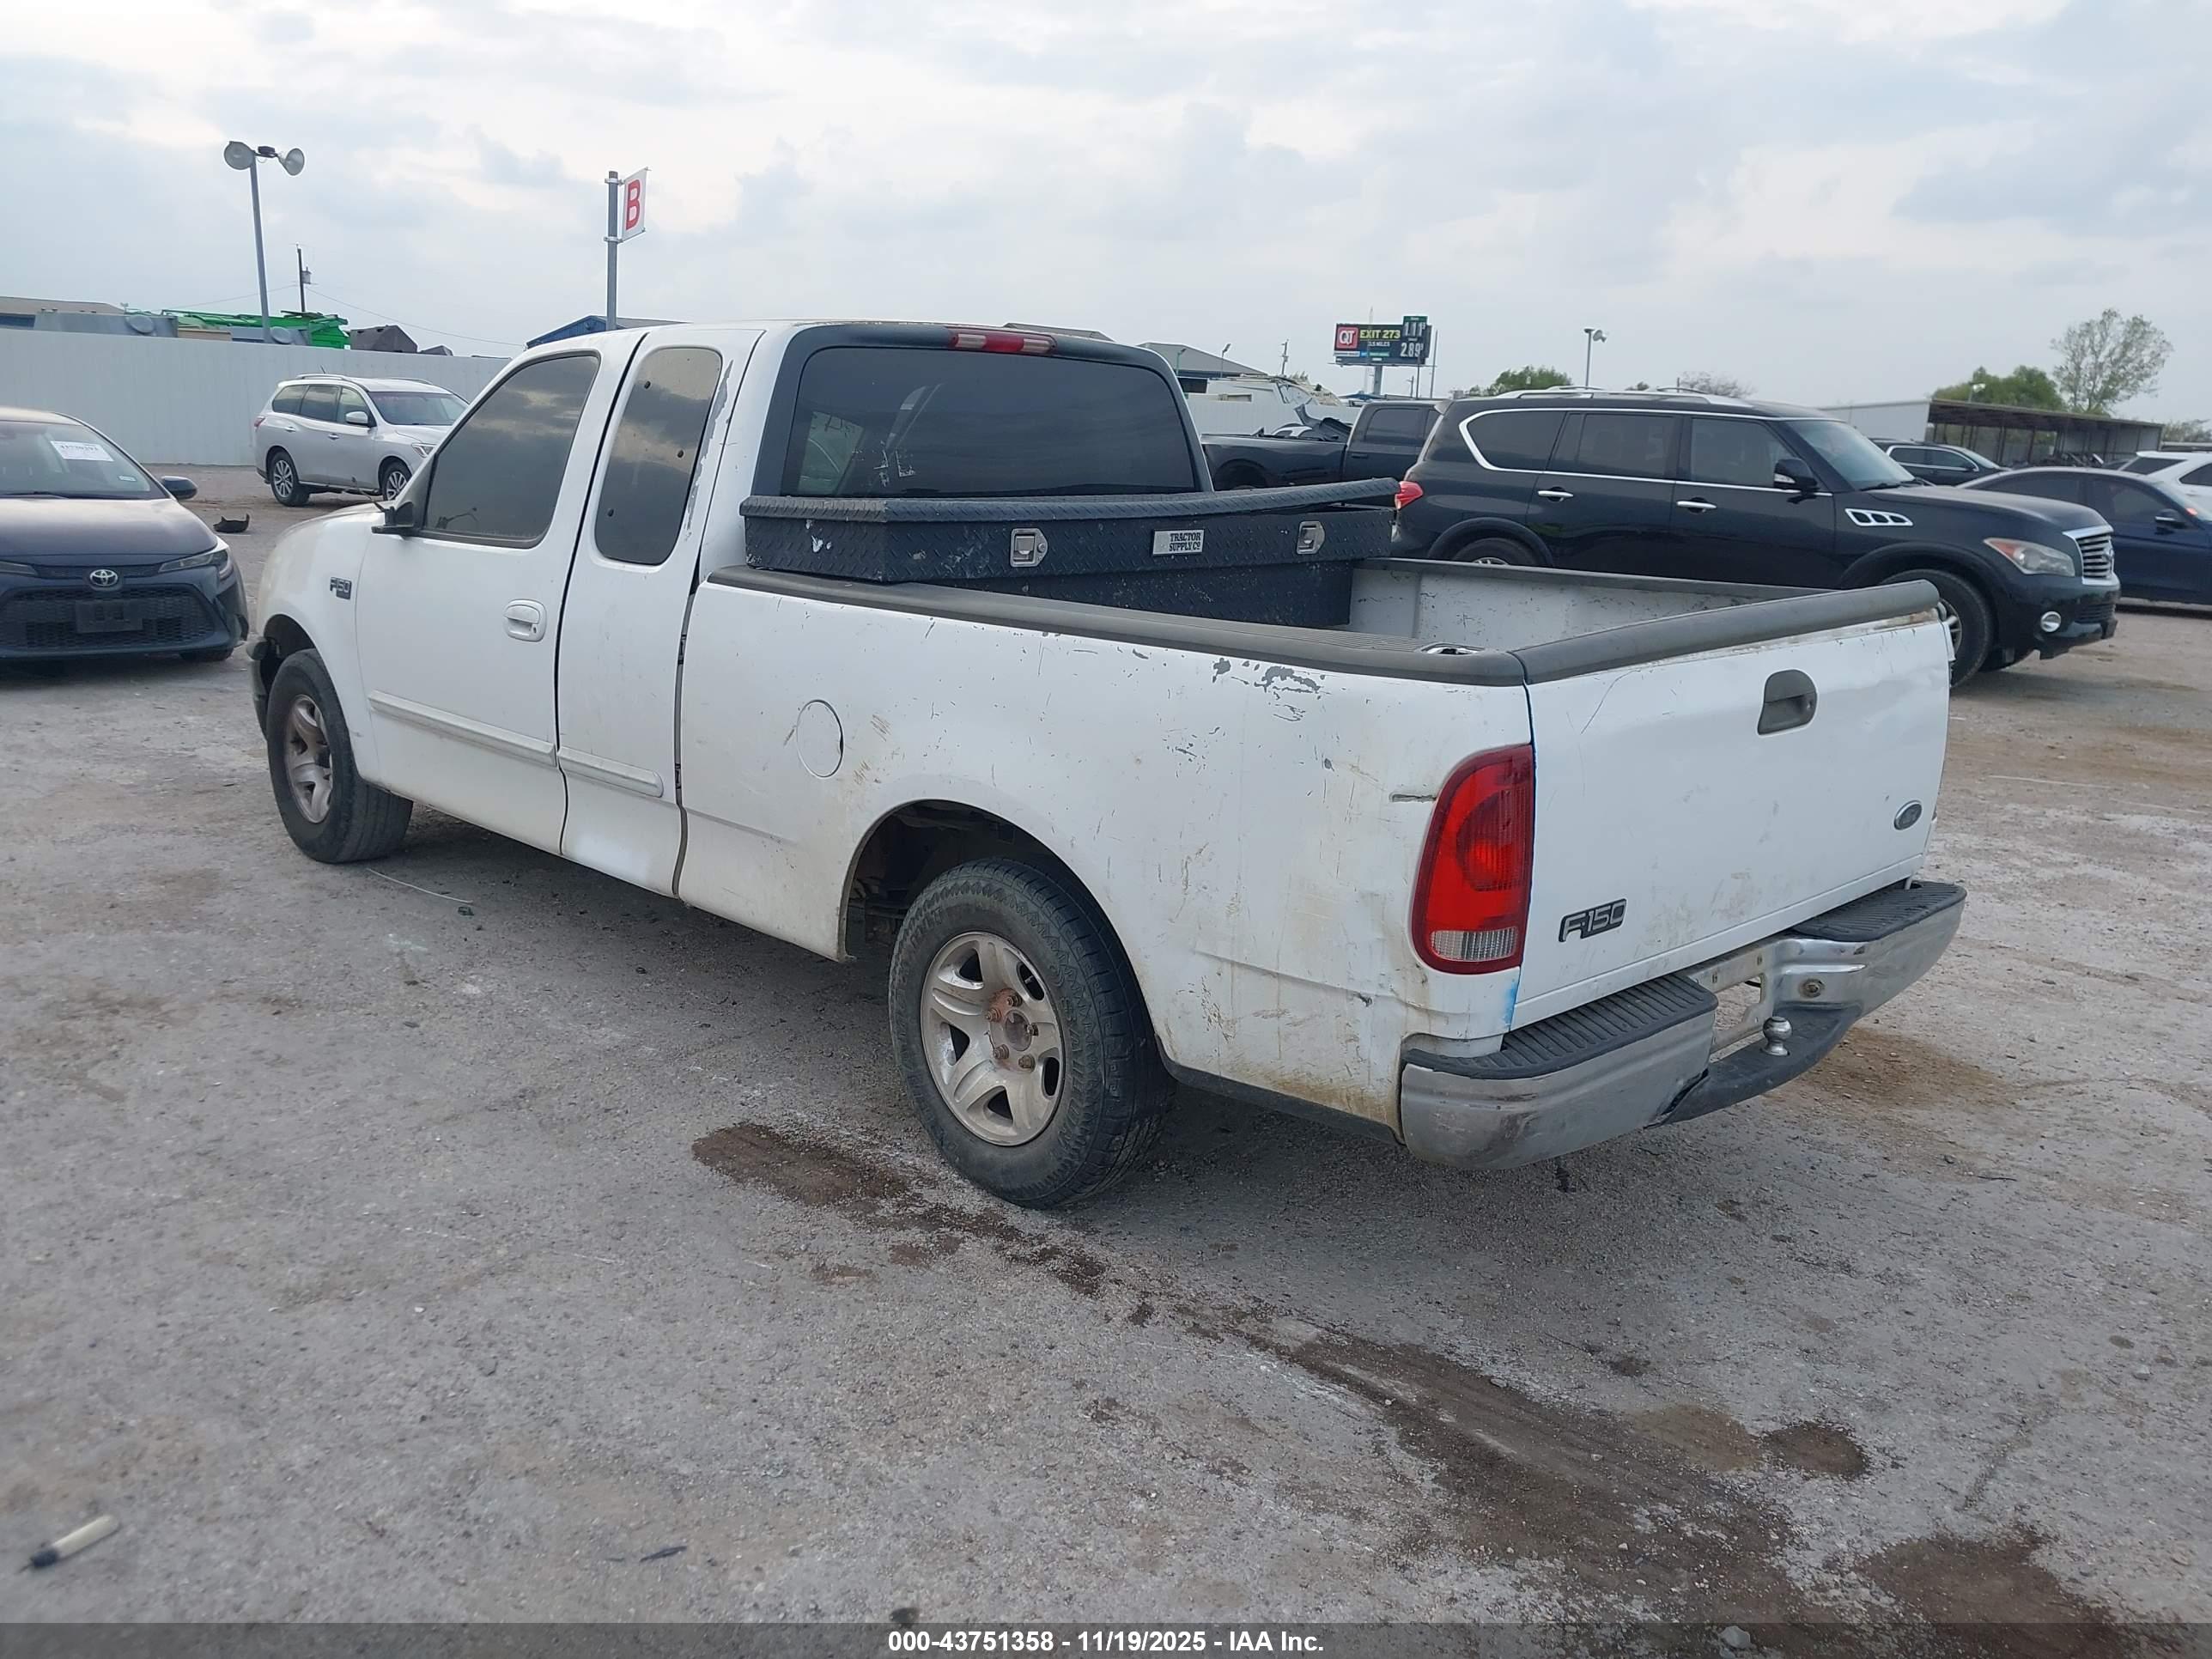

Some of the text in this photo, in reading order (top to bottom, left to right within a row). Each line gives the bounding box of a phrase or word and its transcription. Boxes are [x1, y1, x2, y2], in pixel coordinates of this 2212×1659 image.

[625, 179, 641, 230] B
[1339, 330, 1355, 345] QT
[1359, 329, 1401, 338] EXIT 273
[1170, 532, 1200, 542] TRACTOR
[1169, 542, 1192, 551] SUPPLY
